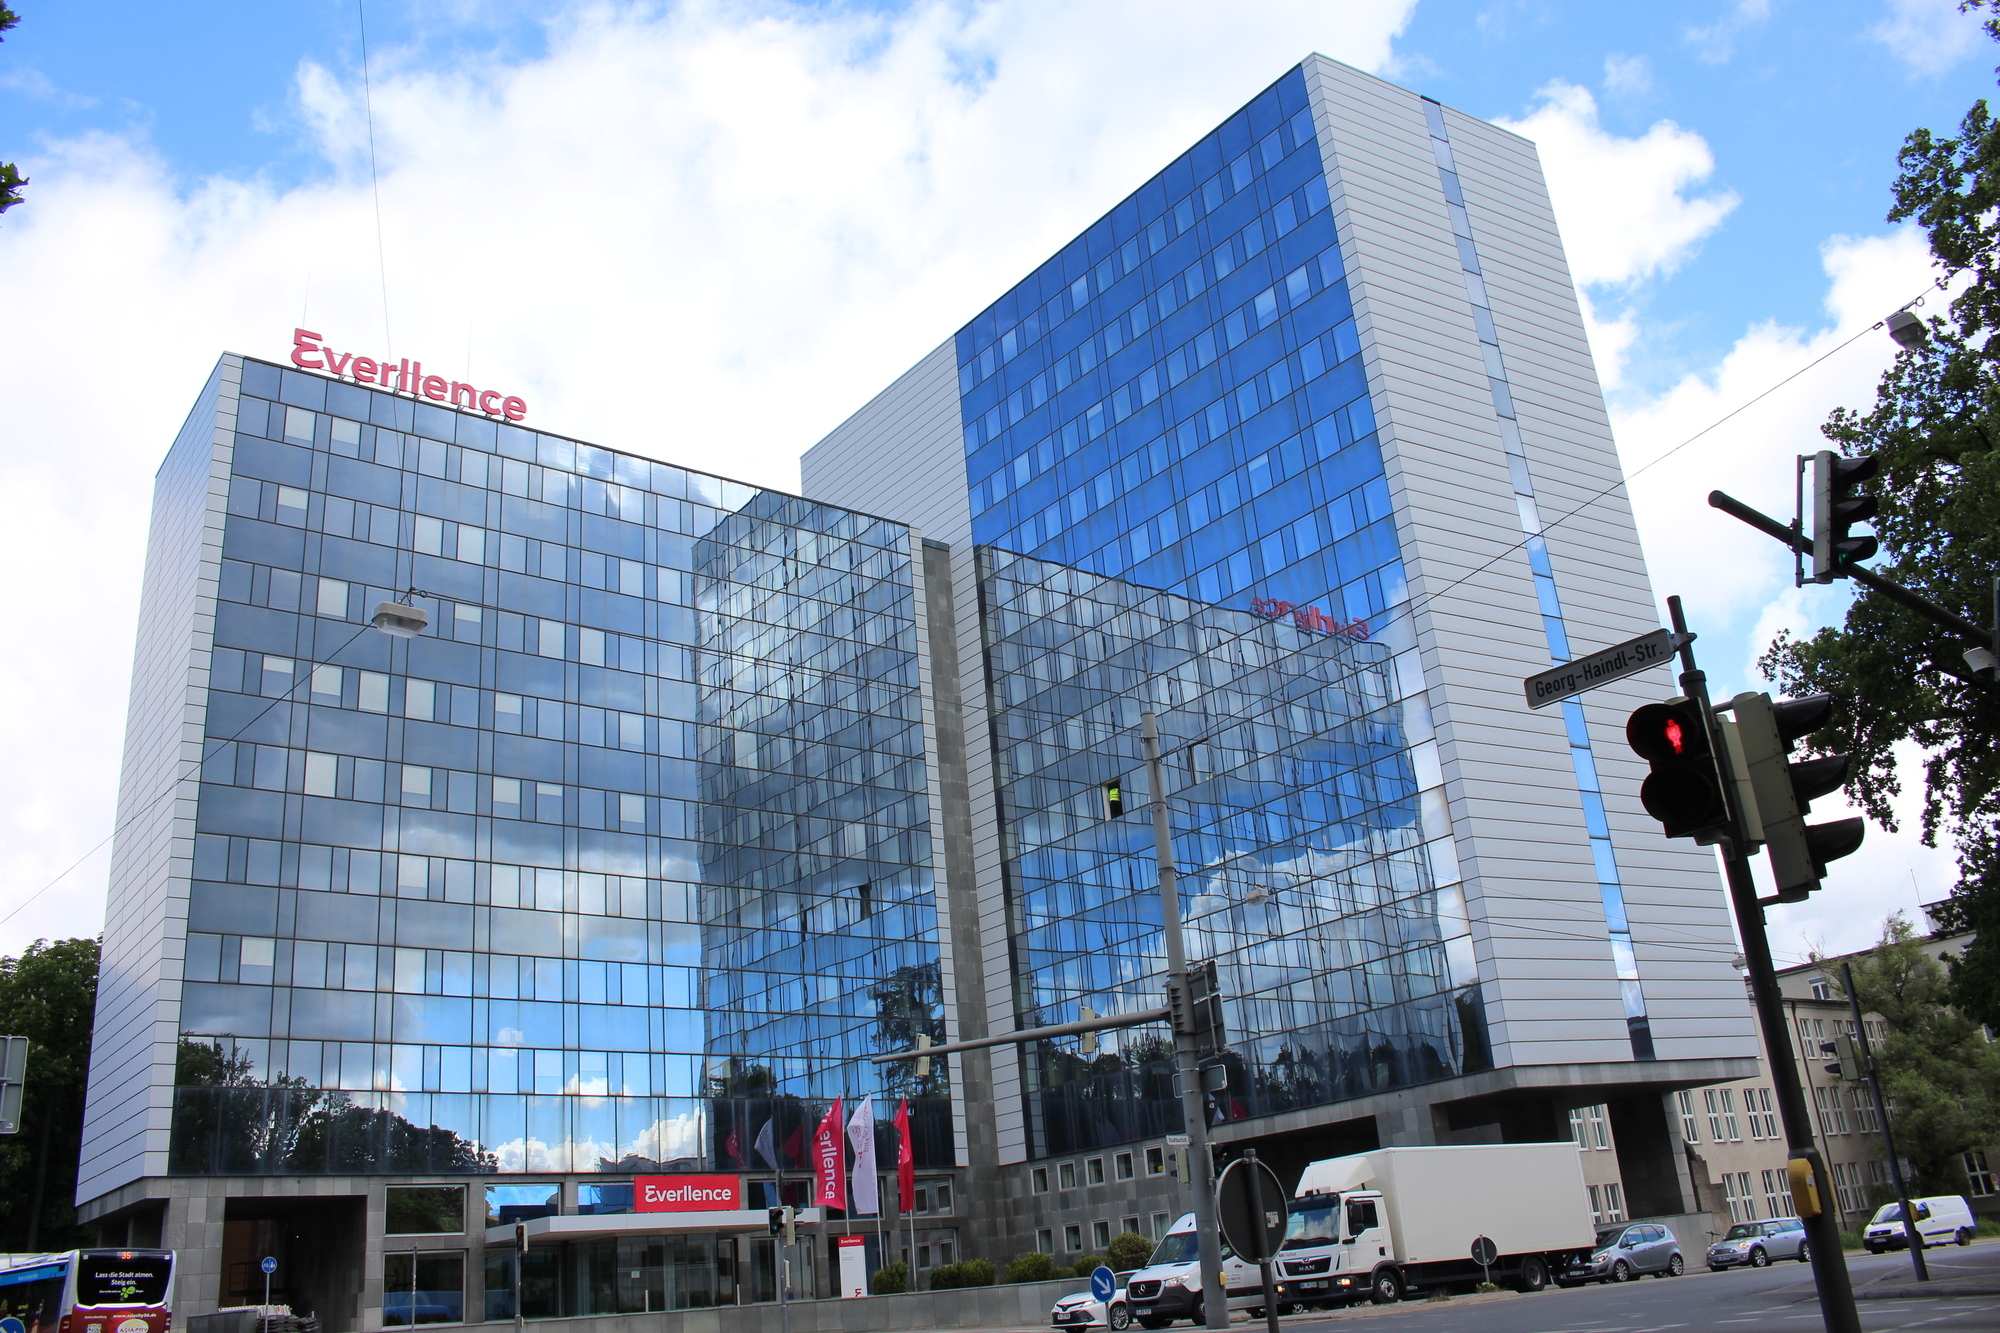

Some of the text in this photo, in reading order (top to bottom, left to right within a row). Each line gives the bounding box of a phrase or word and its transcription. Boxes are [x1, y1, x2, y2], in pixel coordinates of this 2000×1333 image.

[291, 328, 527, 421] Everllence
[1535, 641, 1664, 699] Georg-Haindl-Str.
[645, 1185, 732, 1203] Everllence
[121, 1251, 132, 1260] 35
[1298, 1264, 1315, 1272] MAN
